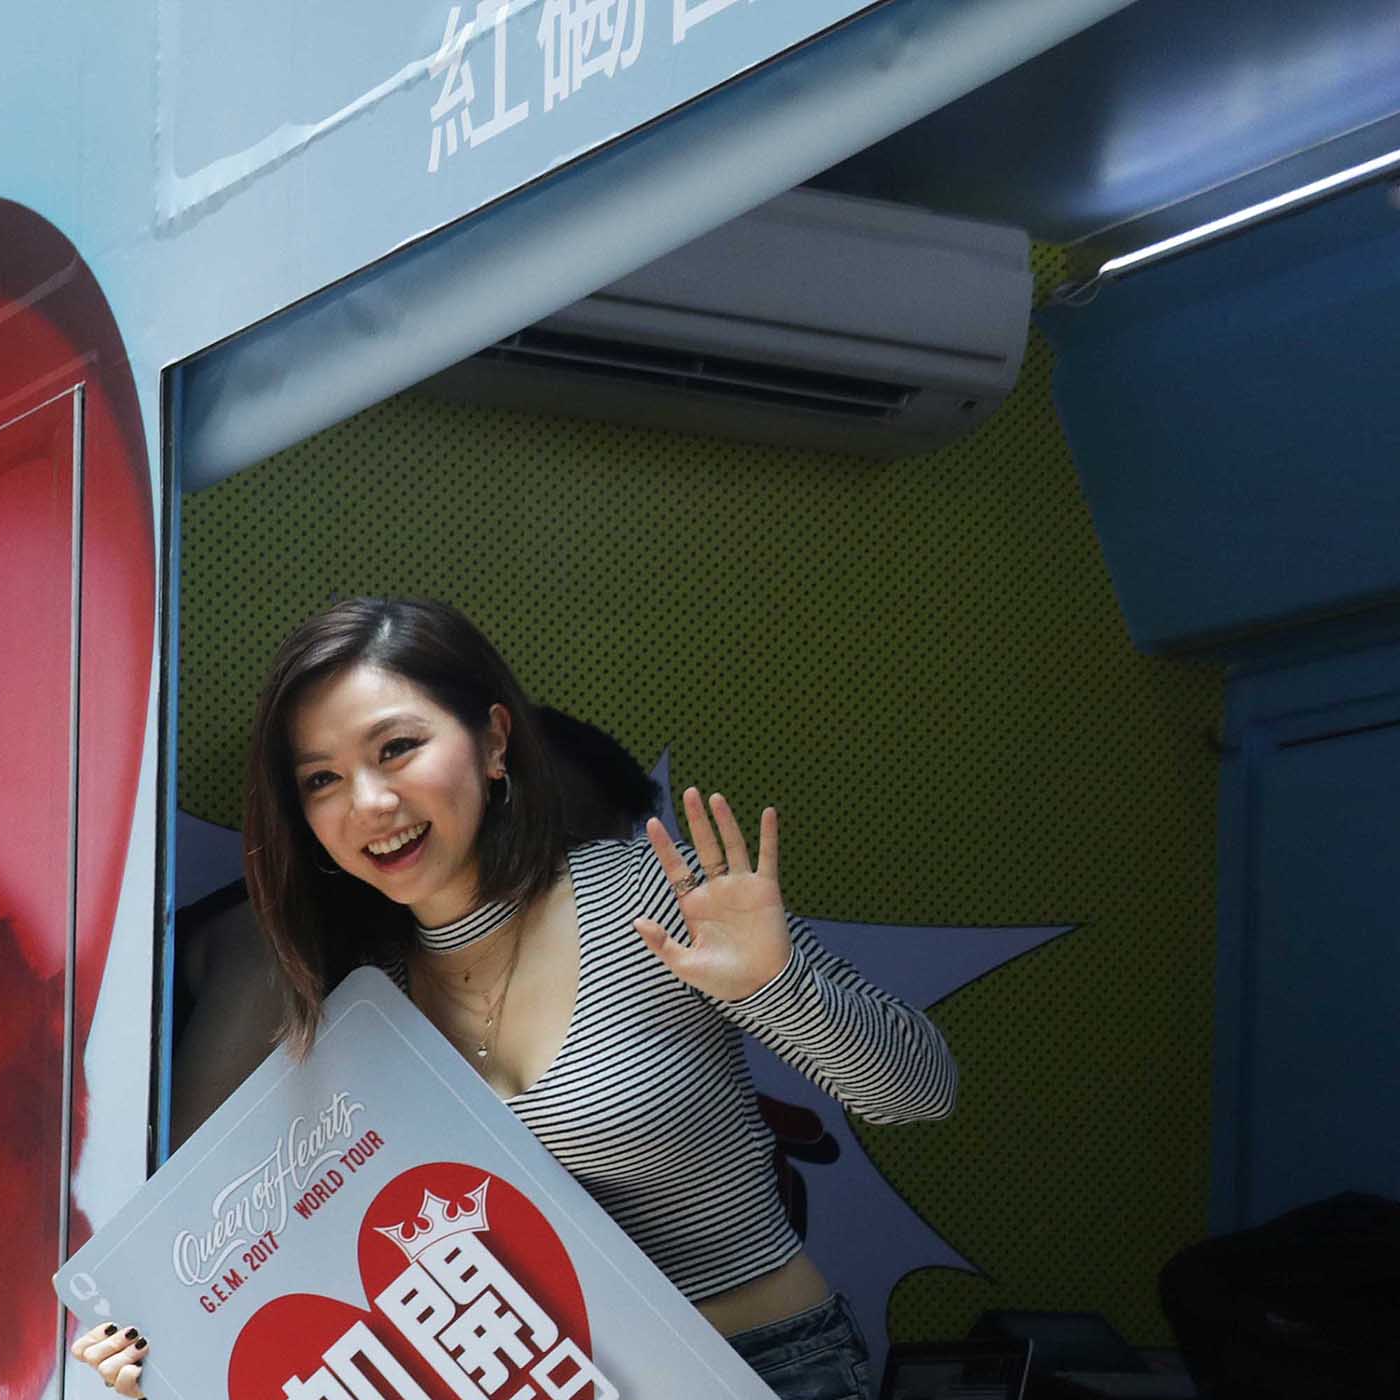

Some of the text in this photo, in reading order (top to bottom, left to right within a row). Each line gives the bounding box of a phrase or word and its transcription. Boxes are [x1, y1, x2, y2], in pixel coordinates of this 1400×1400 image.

[173, 1091, 366, 1286] Queen of Hearts
[199, 1128, 386, 1314] G.E.M. 2017 WORLD TOUR
[70, 1272, 99, 1301] Q
